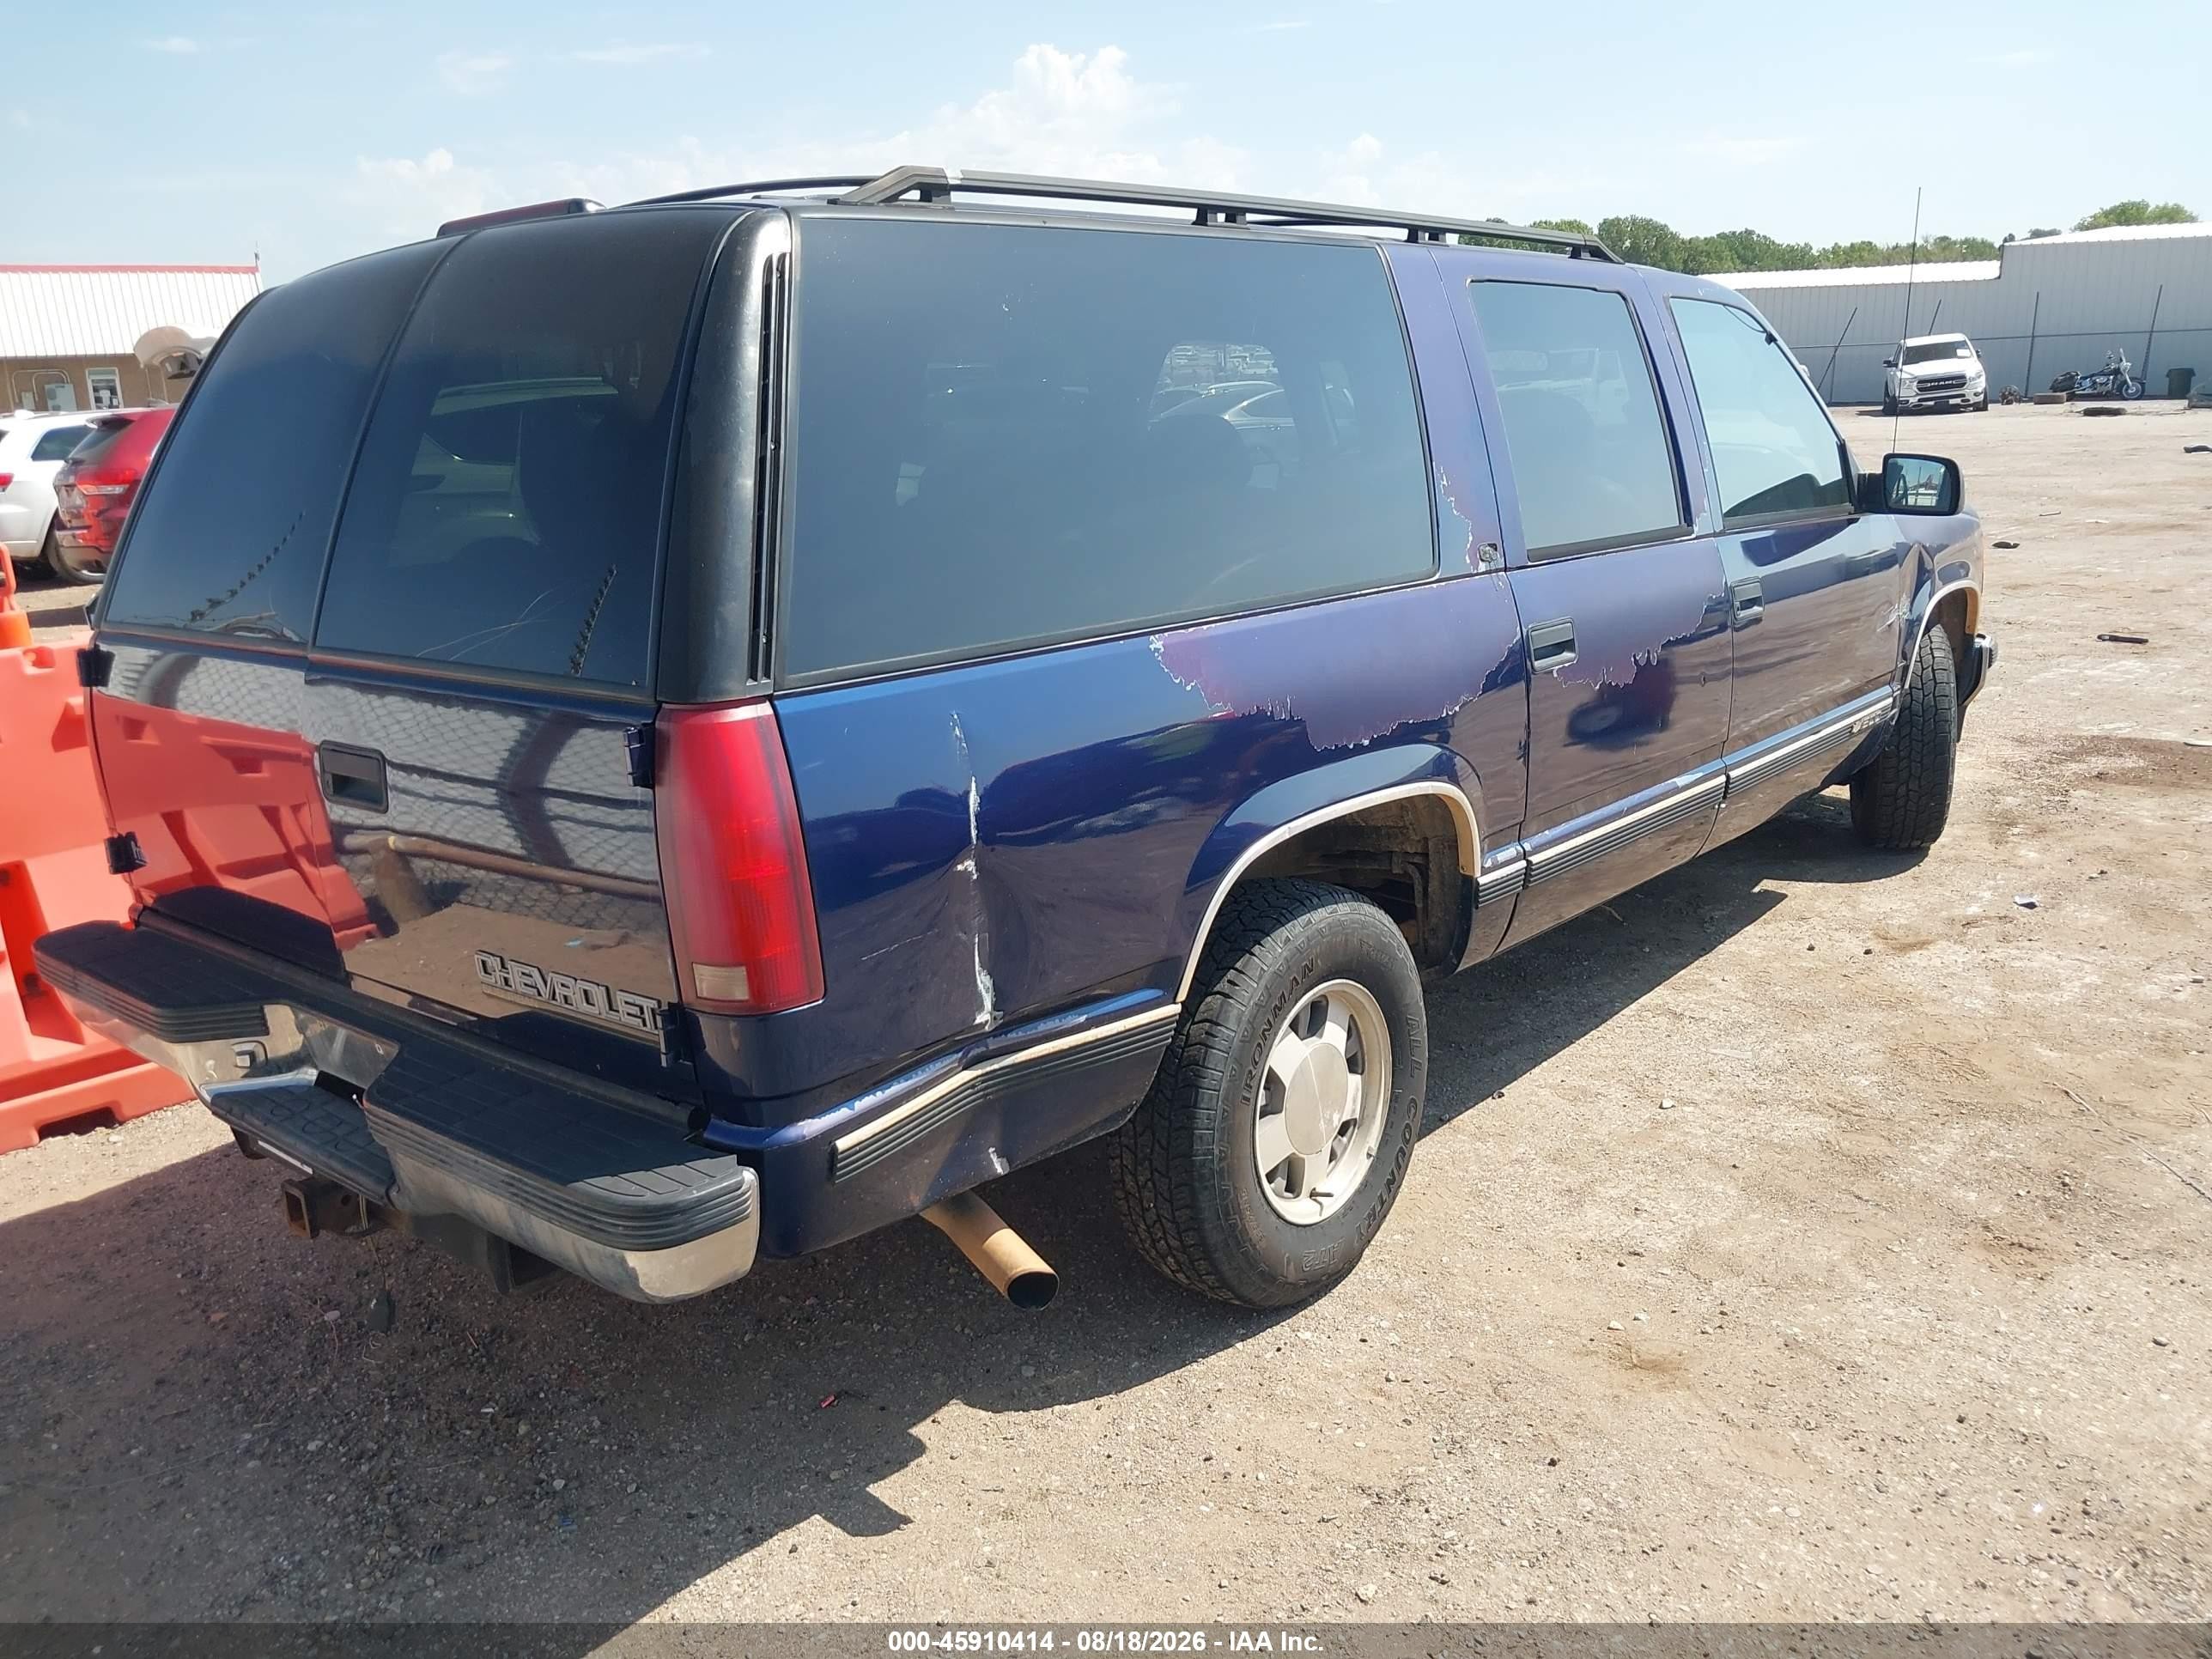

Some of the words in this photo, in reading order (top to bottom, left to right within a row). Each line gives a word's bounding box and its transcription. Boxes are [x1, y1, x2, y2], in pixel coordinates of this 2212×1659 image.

[474, 950, 663, 1034] CHEVROLET
[1239, 956, 1316, 1107] IRONMAN
[1406, 1014, 1423, 1079] ALL
[1354, 1095, 1419, 1244] COUNTRY
